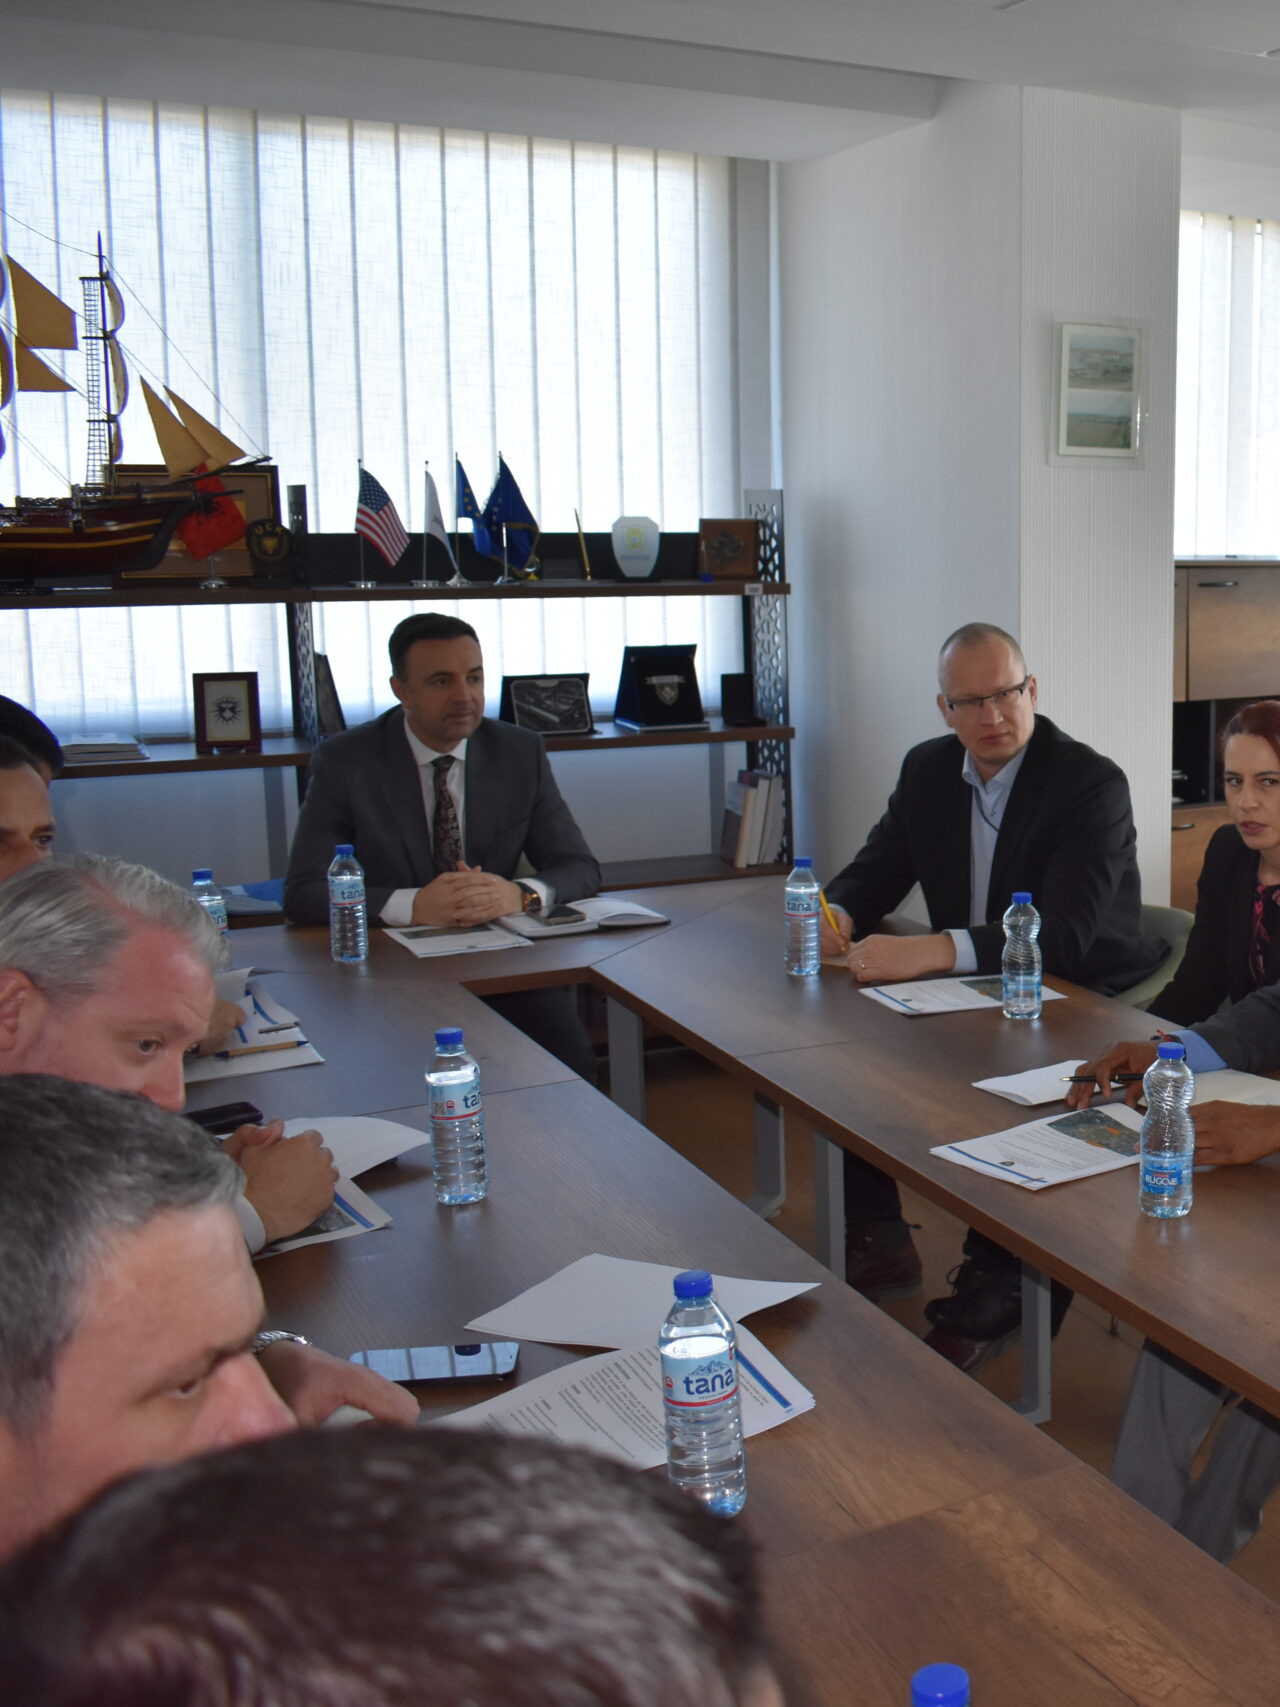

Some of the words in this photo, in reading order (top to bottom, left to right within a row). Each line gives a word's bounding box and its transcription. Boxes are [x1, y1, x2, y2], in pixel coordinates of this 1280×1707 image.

[787, 901, 811, 912] tana
[1145, 1174, 1178, 1186] RUGOVE
[683, 1367, 734, 1395] tana
